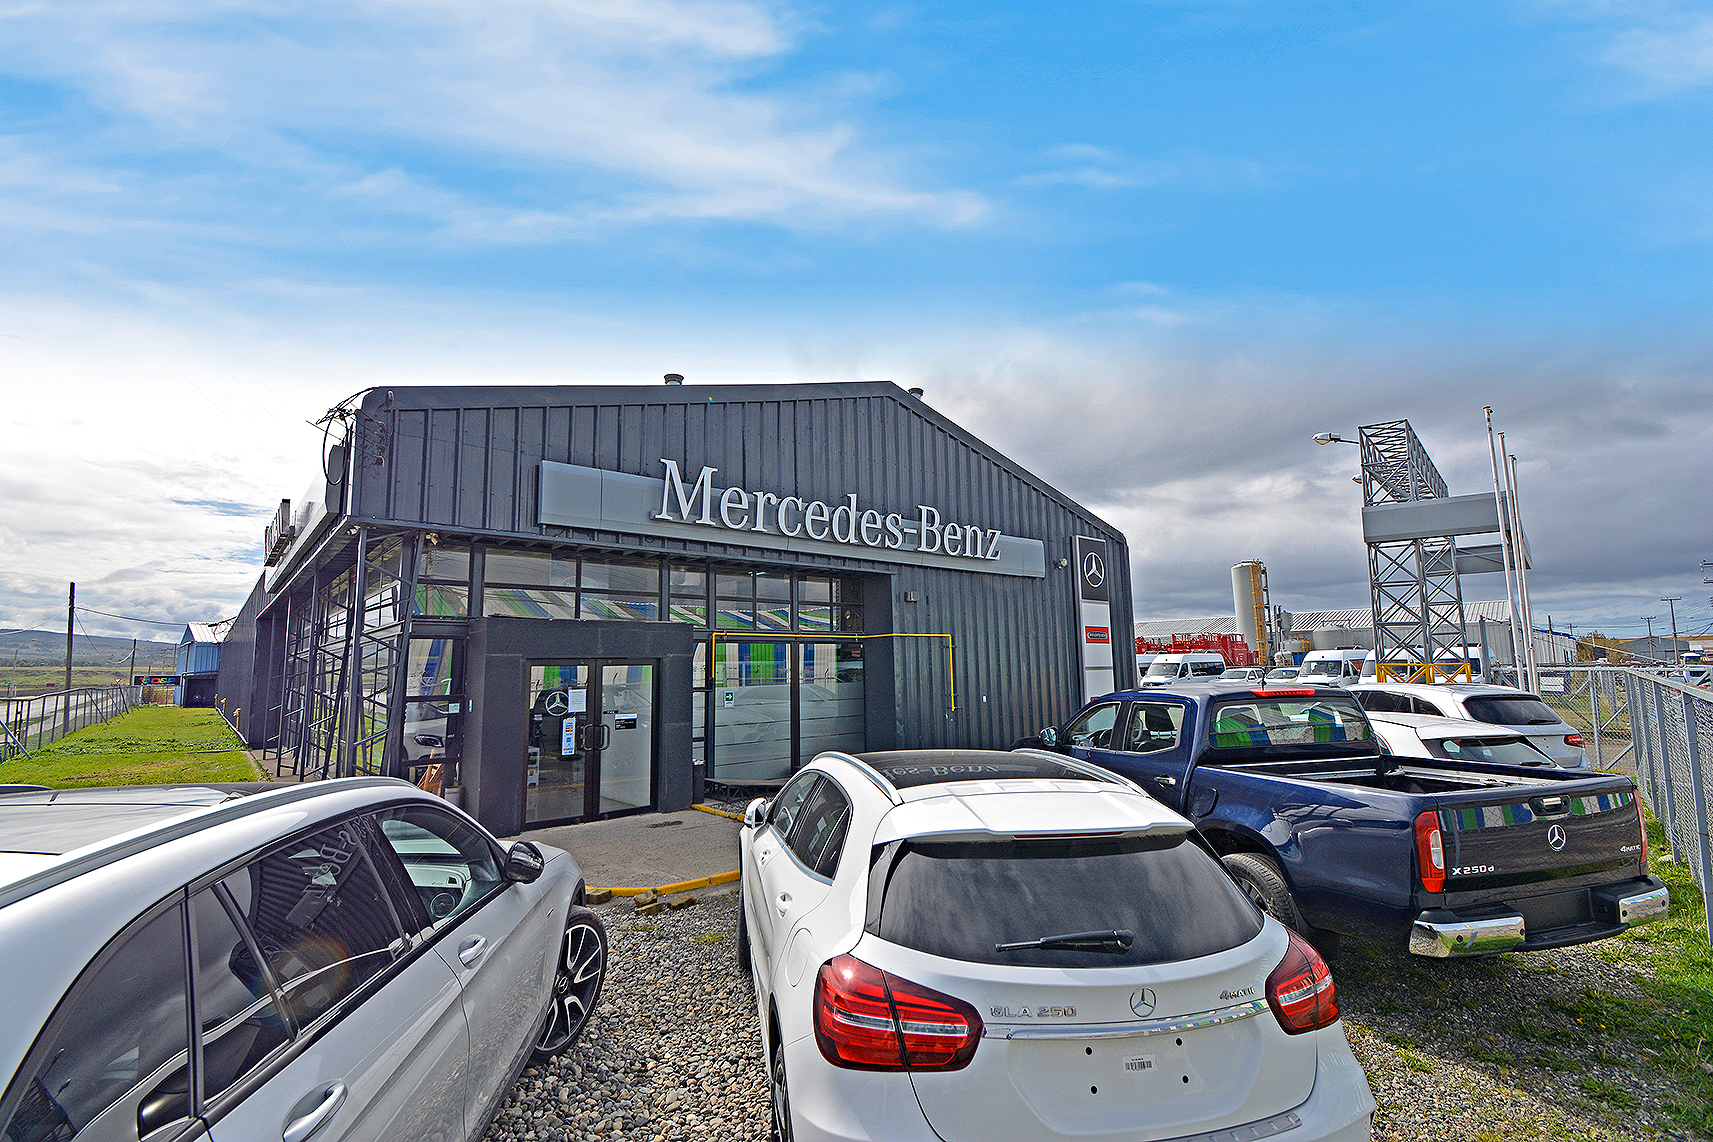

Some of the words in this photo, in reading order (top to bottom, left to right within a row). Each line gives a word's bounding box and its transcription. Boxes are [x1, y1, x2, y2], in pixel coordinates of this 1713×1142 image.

[655, 458, 1001, 560] Mercedes-Benz
[990, 1005, 1033, 1018] GLA
[1037, 1005, 1076, 1018] 250
